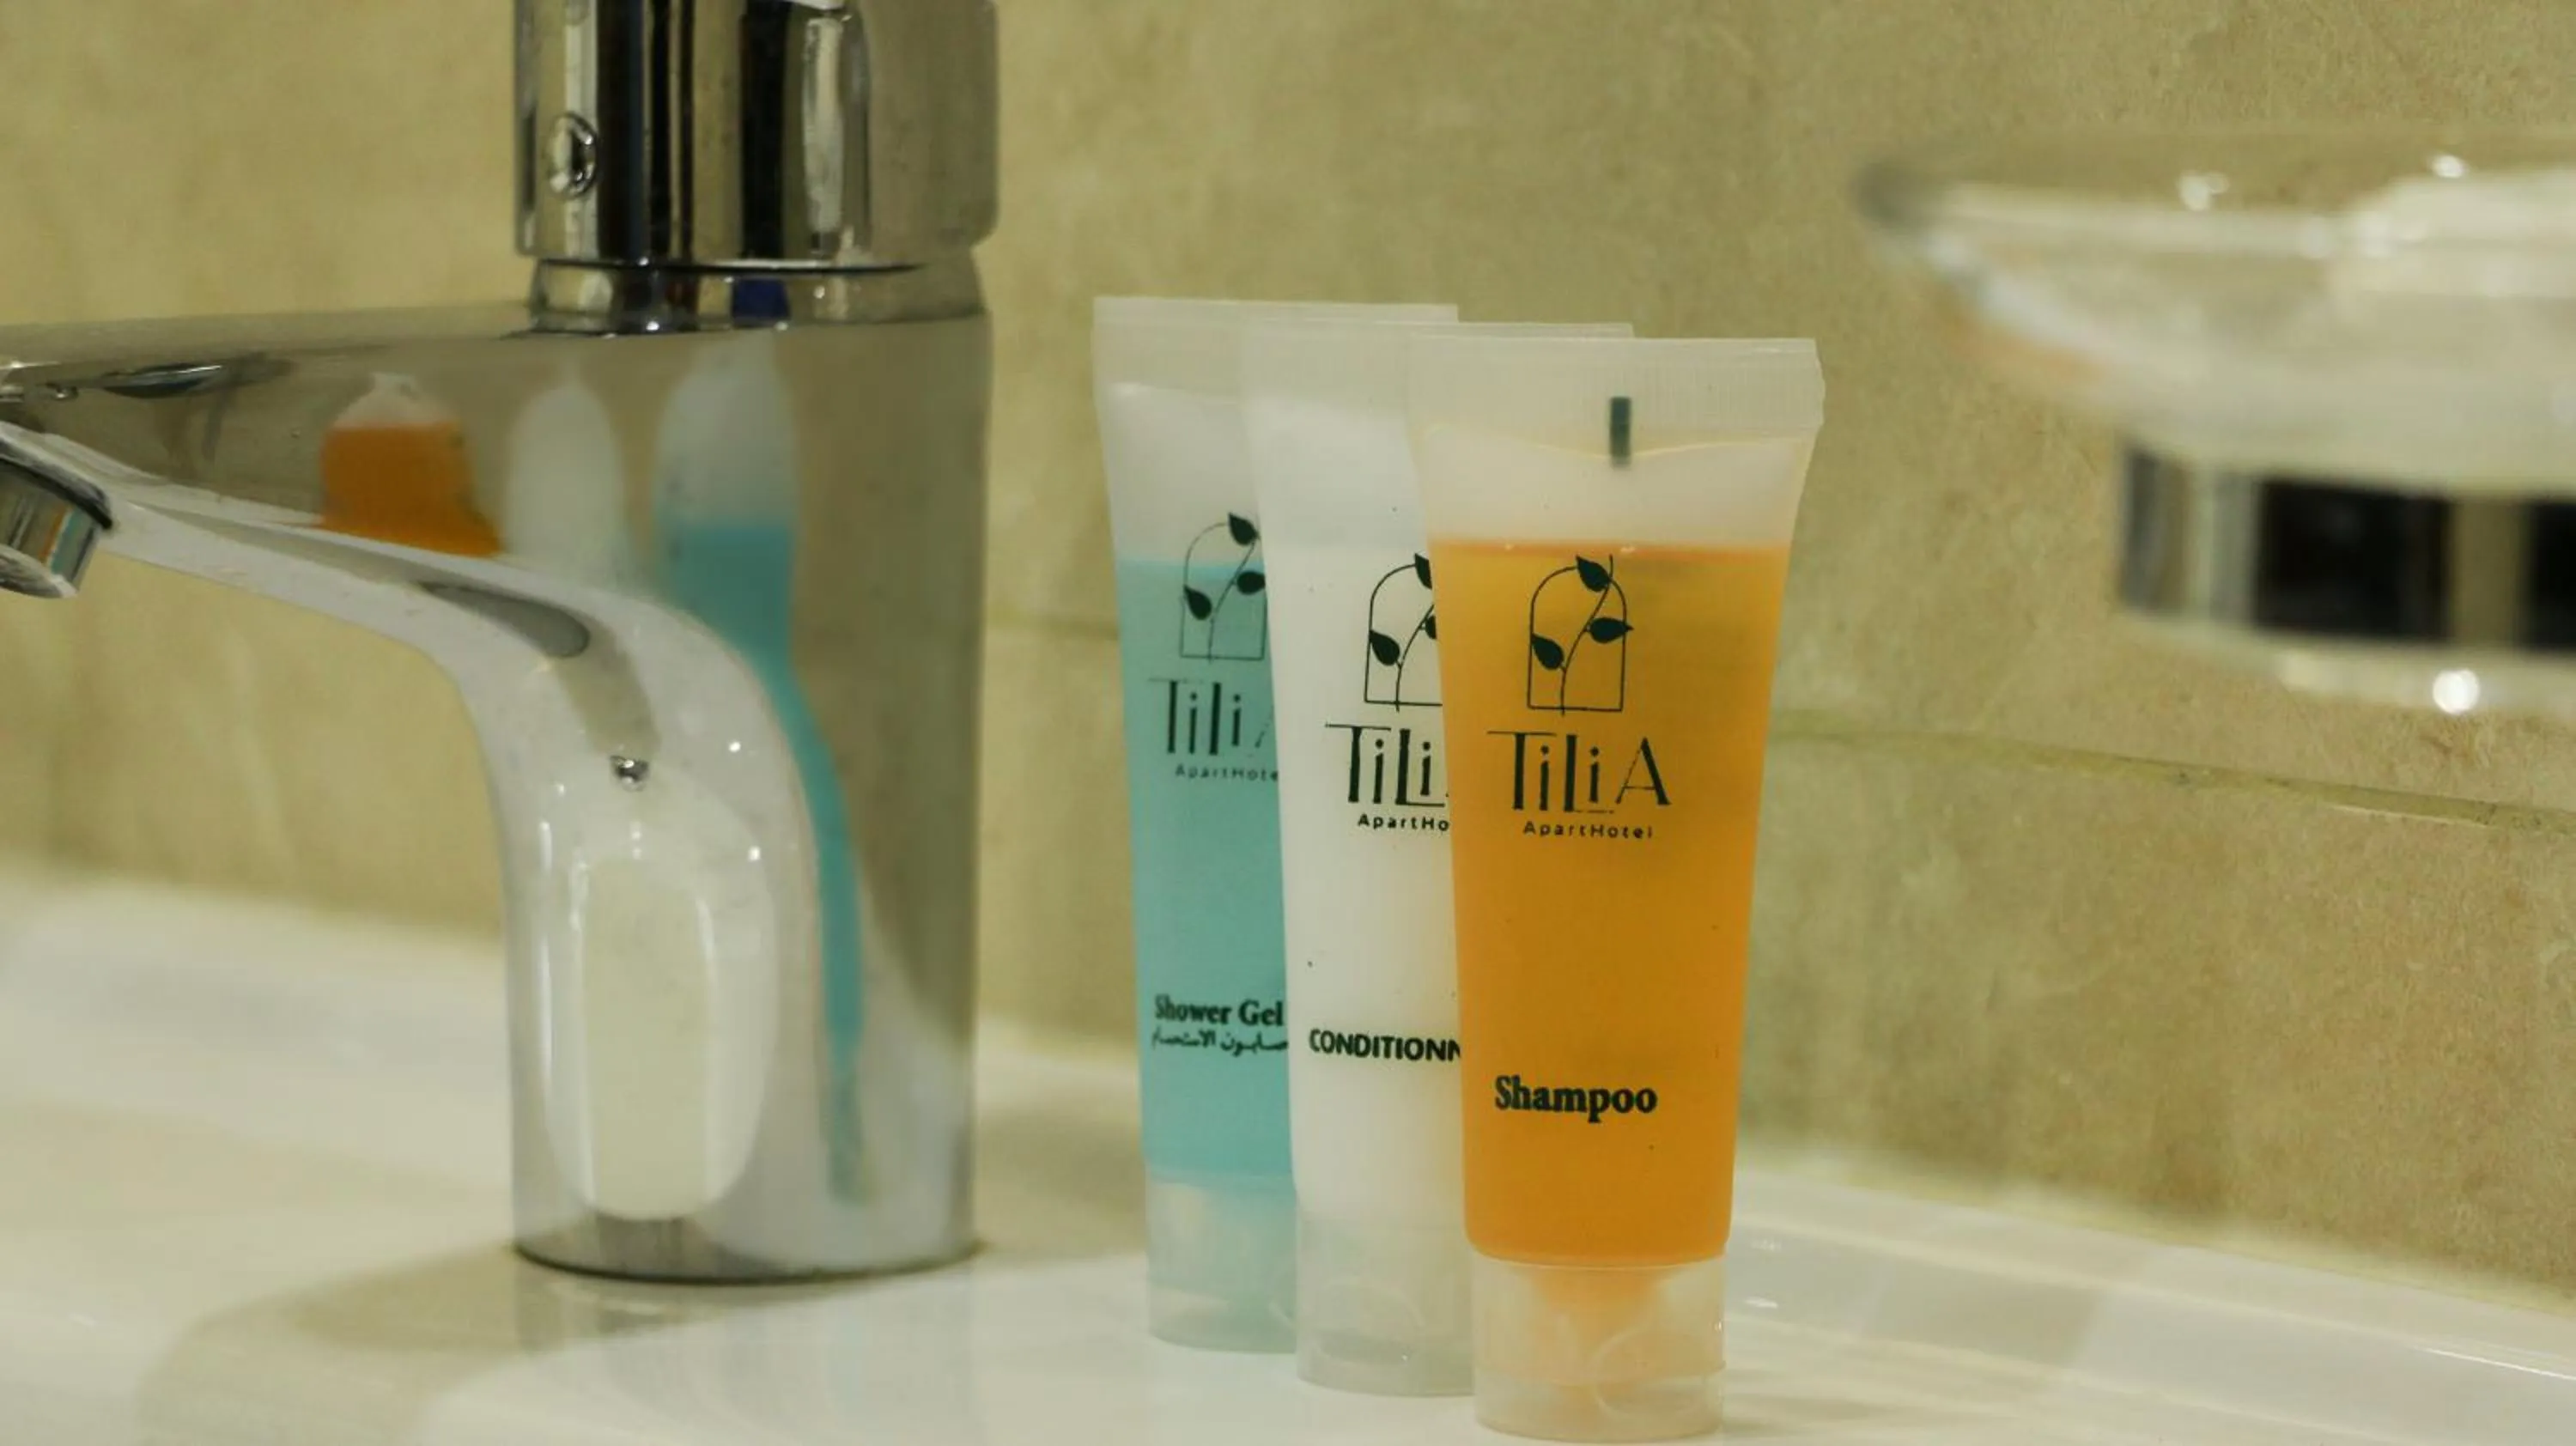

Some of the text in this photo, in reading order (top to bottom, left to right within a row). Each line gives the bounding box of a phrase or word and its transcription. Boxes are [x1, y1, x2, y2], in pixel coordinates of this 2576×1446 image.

[1176, 763, 1279, 782] ApartHote
[1325, 722, 1449, 808] TiLi
[1358, 813, 1449, 832] ApartHo
[1523, 820, 1654, 839] ApartHotel
[1155, 993, 1285, 1027] Shower Gel
[1309, 1029, 1461, 1061] CONDITIONN
[1495, 1074, 1659, 1124] Shampoo
